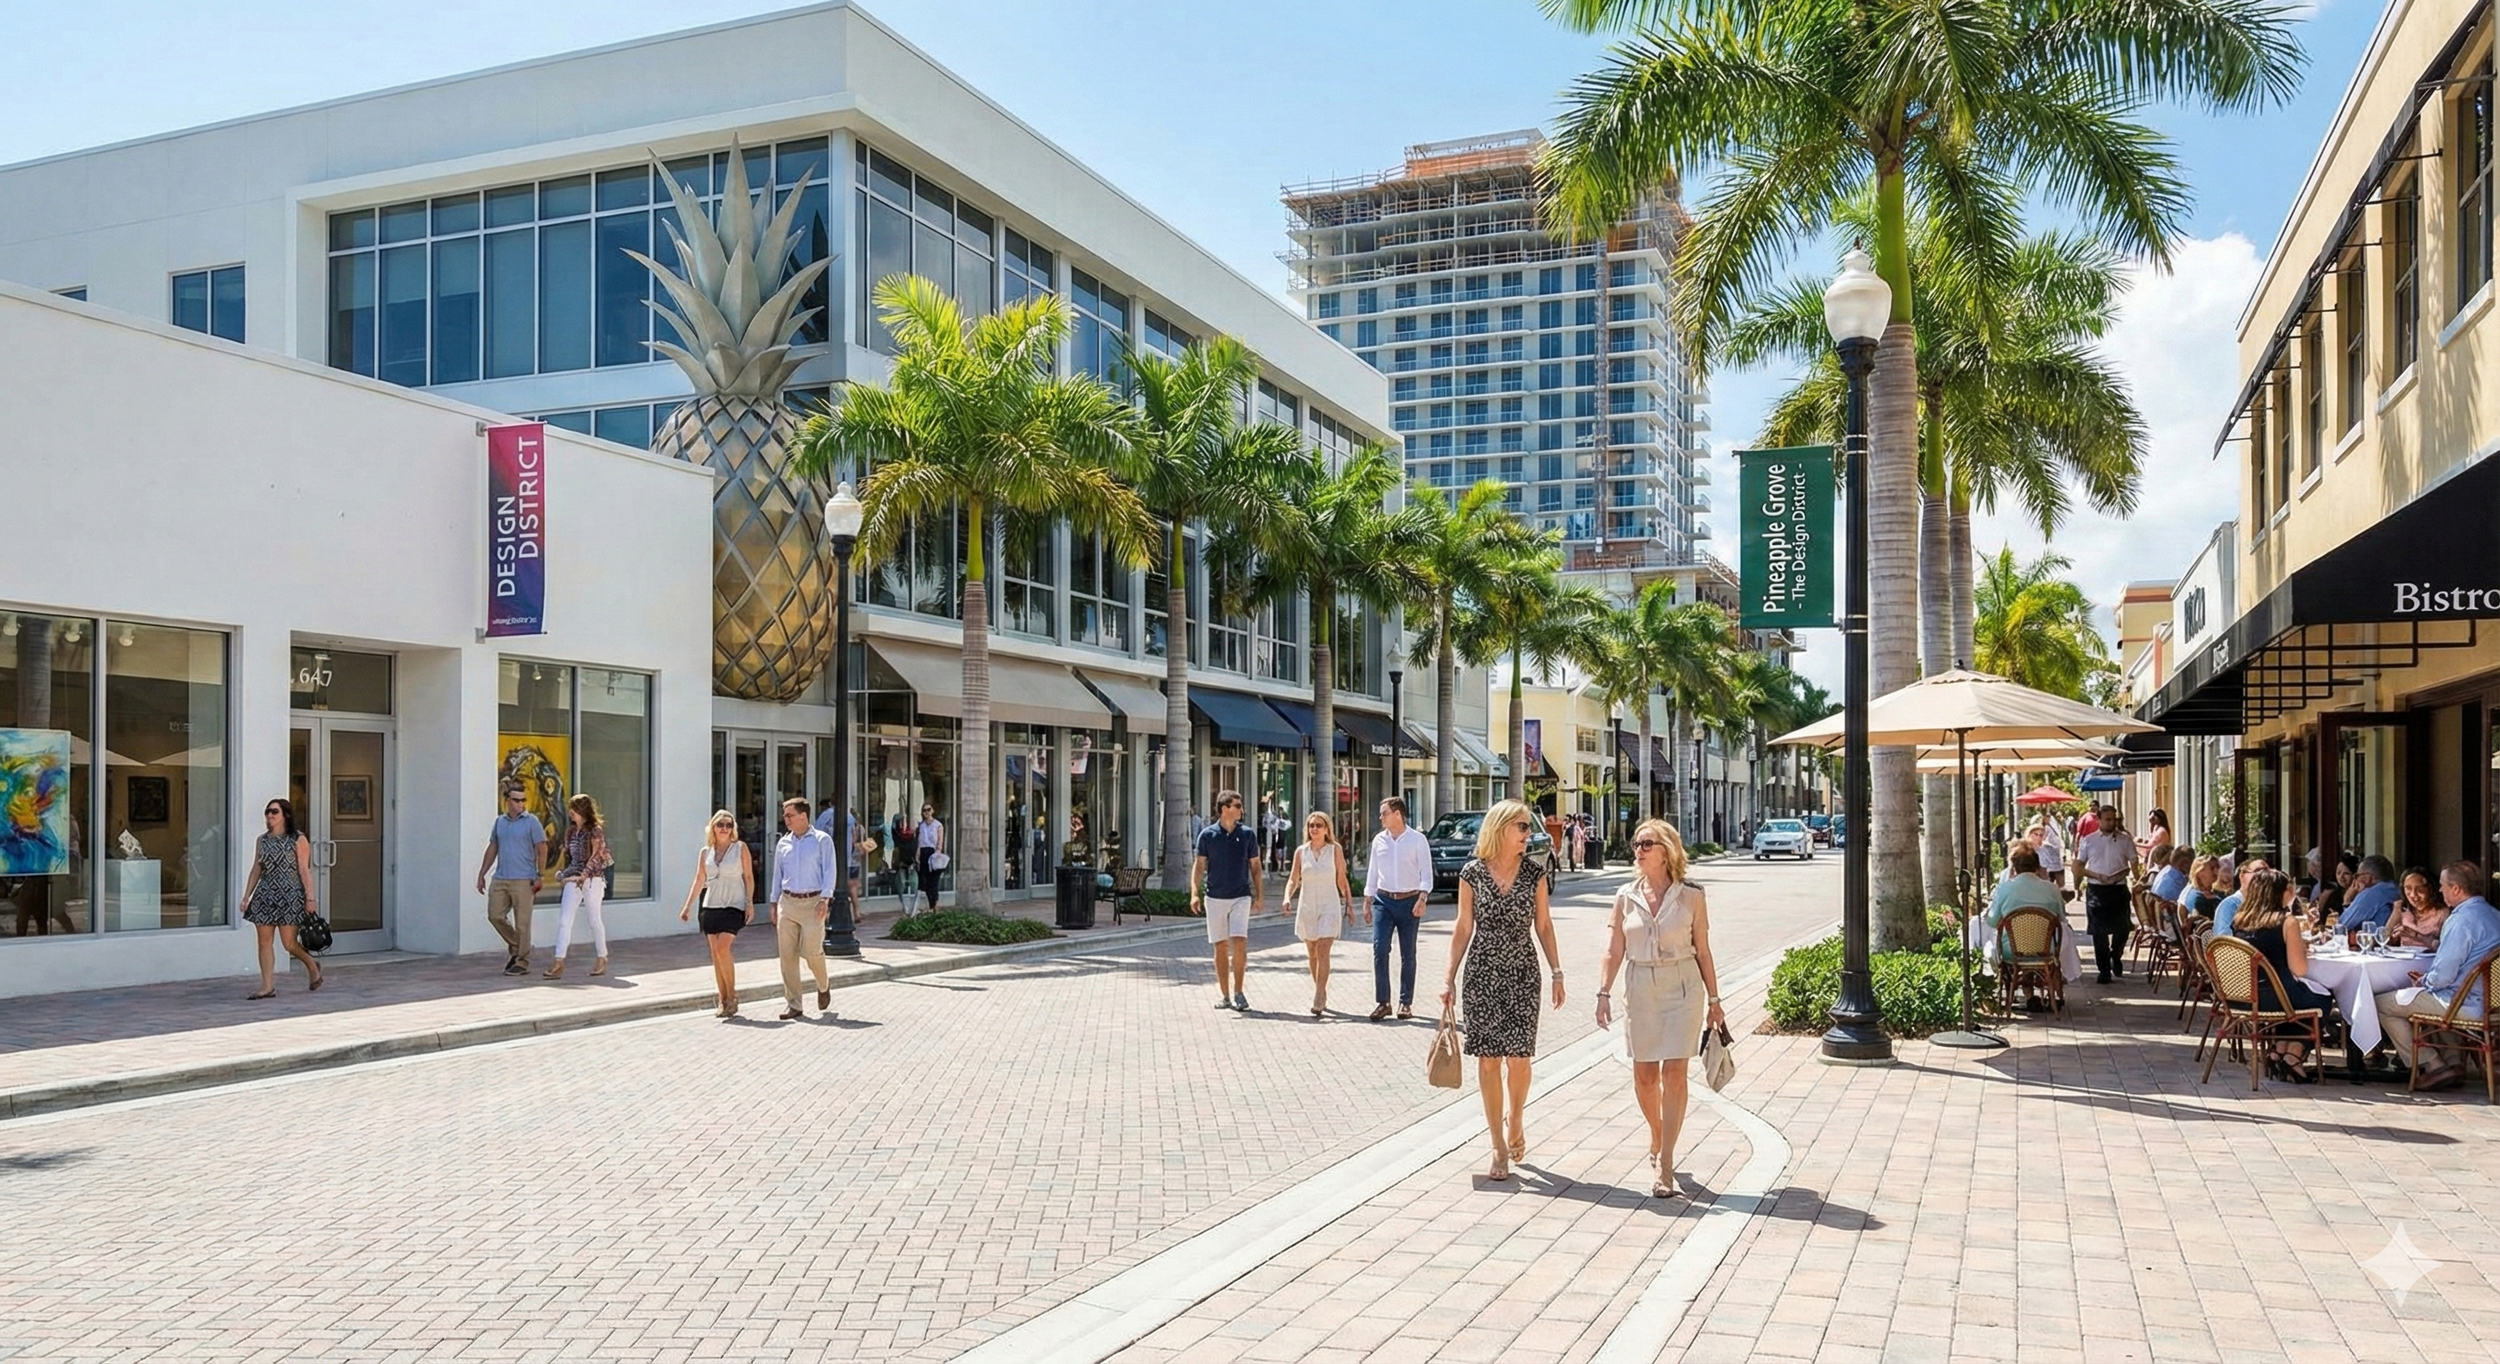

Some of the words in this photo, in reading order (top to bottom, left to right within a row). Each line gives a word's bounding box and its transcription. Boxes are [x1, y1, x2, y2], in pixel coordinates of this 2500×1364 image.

[518, 436, 539, 559] DISTRICT
[1762, 464, 1786, 517] Grove
[1791, 472, 1806, 521] District
[497, 496, 516, 597] DESIGN
[1762, 521, 1792, 613] Pineapple
[1792, 523, 1810, 571] Design
[1792, 574, 1806, 601] The
[2393, 582, 2500, 614] Bistro
